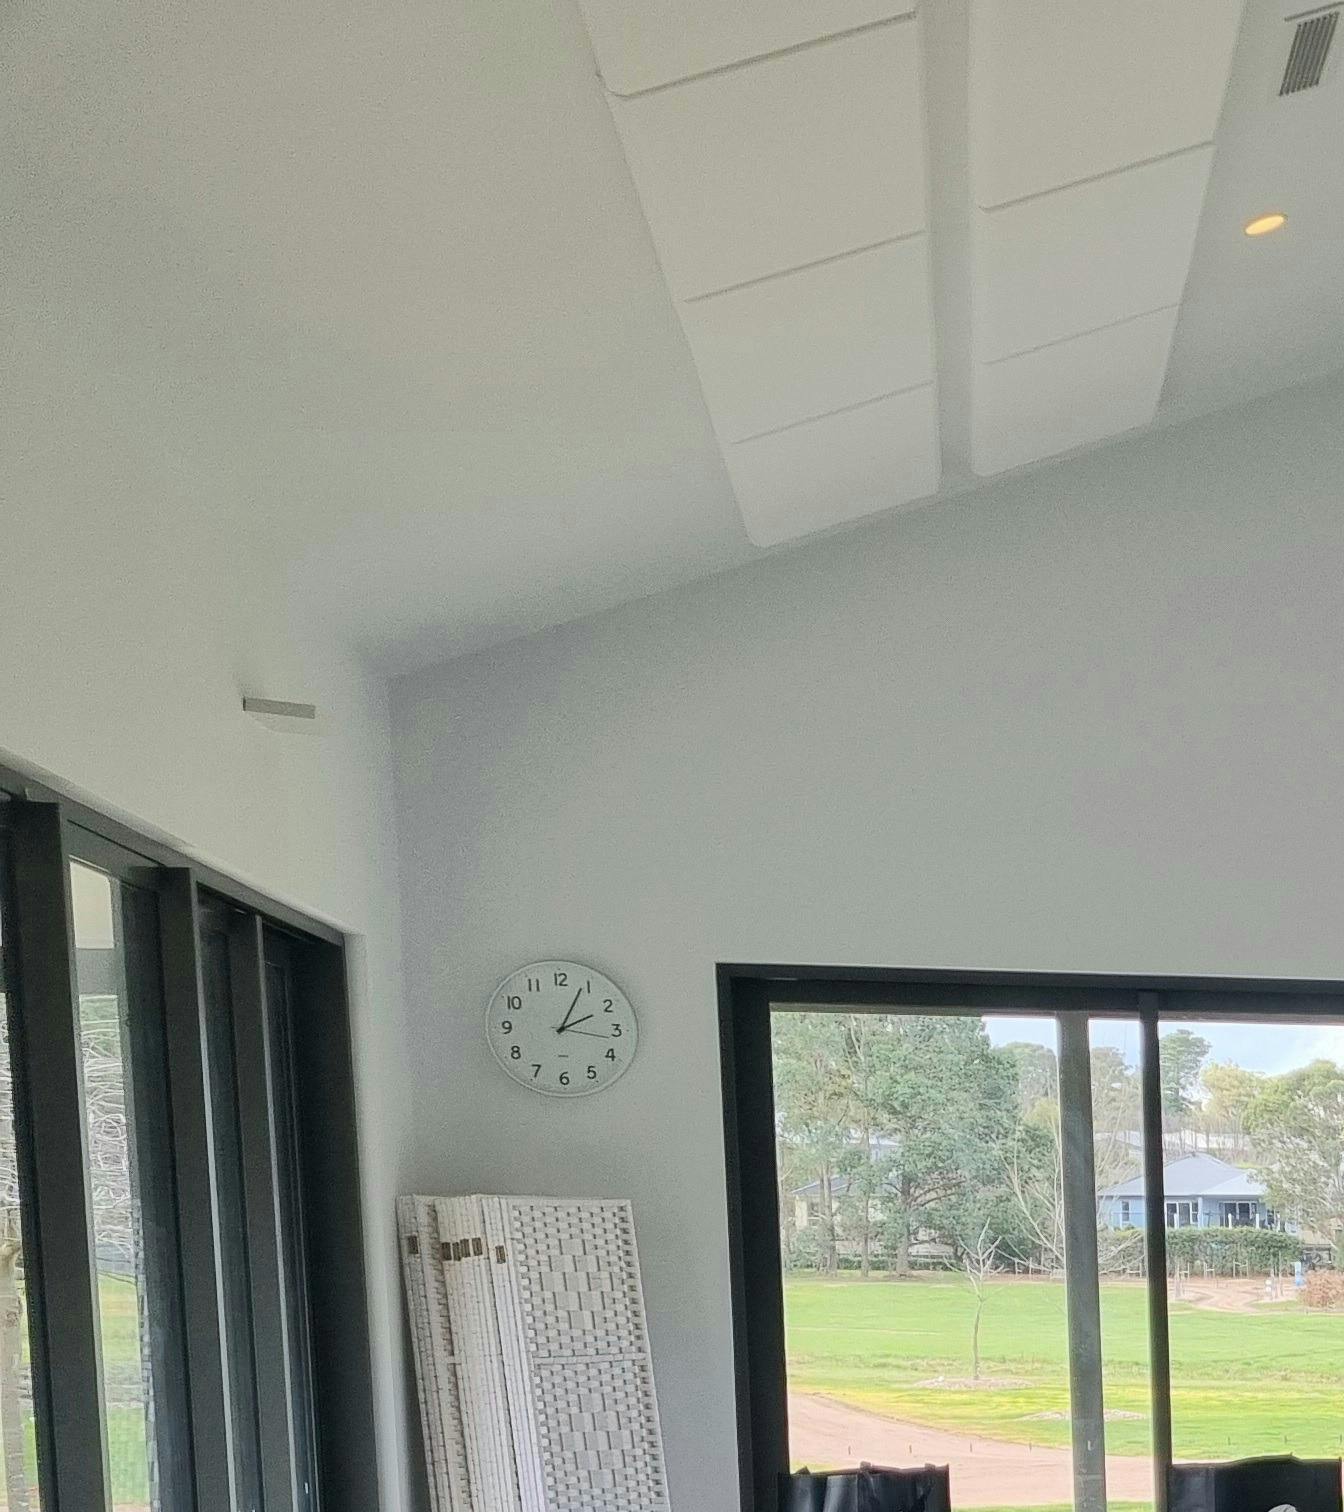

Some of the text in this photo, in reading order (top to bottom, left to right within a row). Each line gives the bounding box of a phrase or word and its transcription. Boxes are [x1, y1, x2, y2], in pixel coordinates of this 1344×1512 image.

[528, 978, 540, 992] 11
[554, 973, 568, 986] 12
[586, 980, 591, 993] 1
[507, 996, 522, 1010] 10
[603, 999, 613, 1013] 2
[501, 1021, 512, 1034] 9
[611, 1024, 622, 1037] 3
[510, 1045, 521, 1059] 8
[605, 1048, 616, 1061] 4
[531, 1064, 542, 1078] 7
[559, 1071, 569, 1085] 6
[587, 1065, 597, 1079] 5
